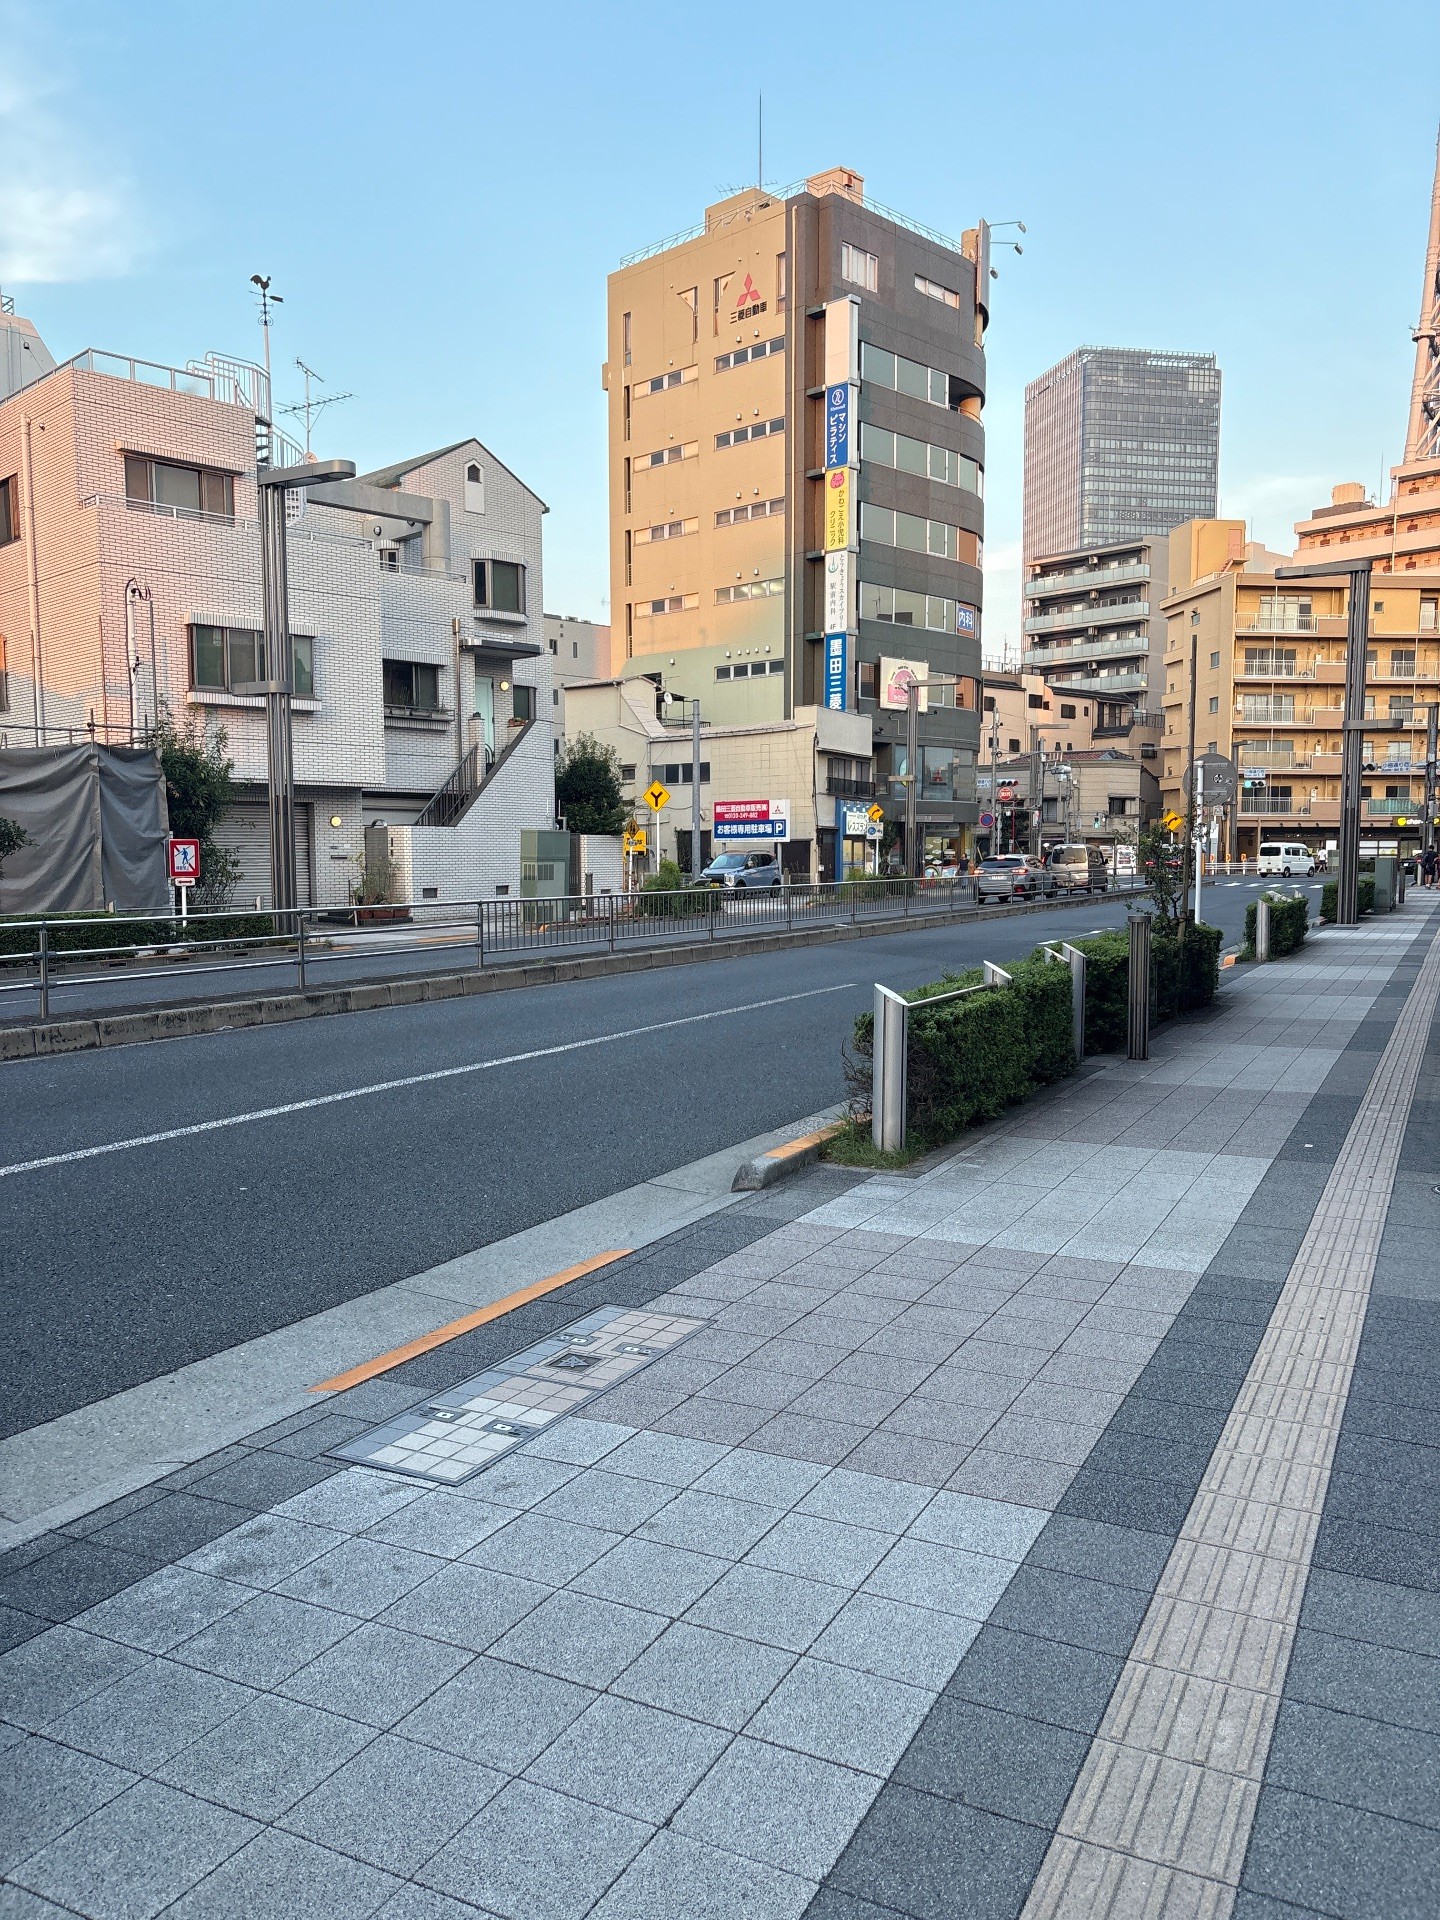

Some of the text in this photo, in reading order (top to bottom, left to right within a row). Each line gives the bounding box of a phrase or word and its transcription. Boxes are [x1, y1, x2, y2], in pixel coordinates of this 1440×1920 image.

[730, 301, 767, 324] 三菱自動車
[830, 413, 838, 465] ピラティス
[838, 412, 847, 443] マシン
[958, 610, 973, 629] 内科
[829, 638, 843, 710] 墨田三菱
[717, 822, 783, 835] お客様専用駐車場 P
